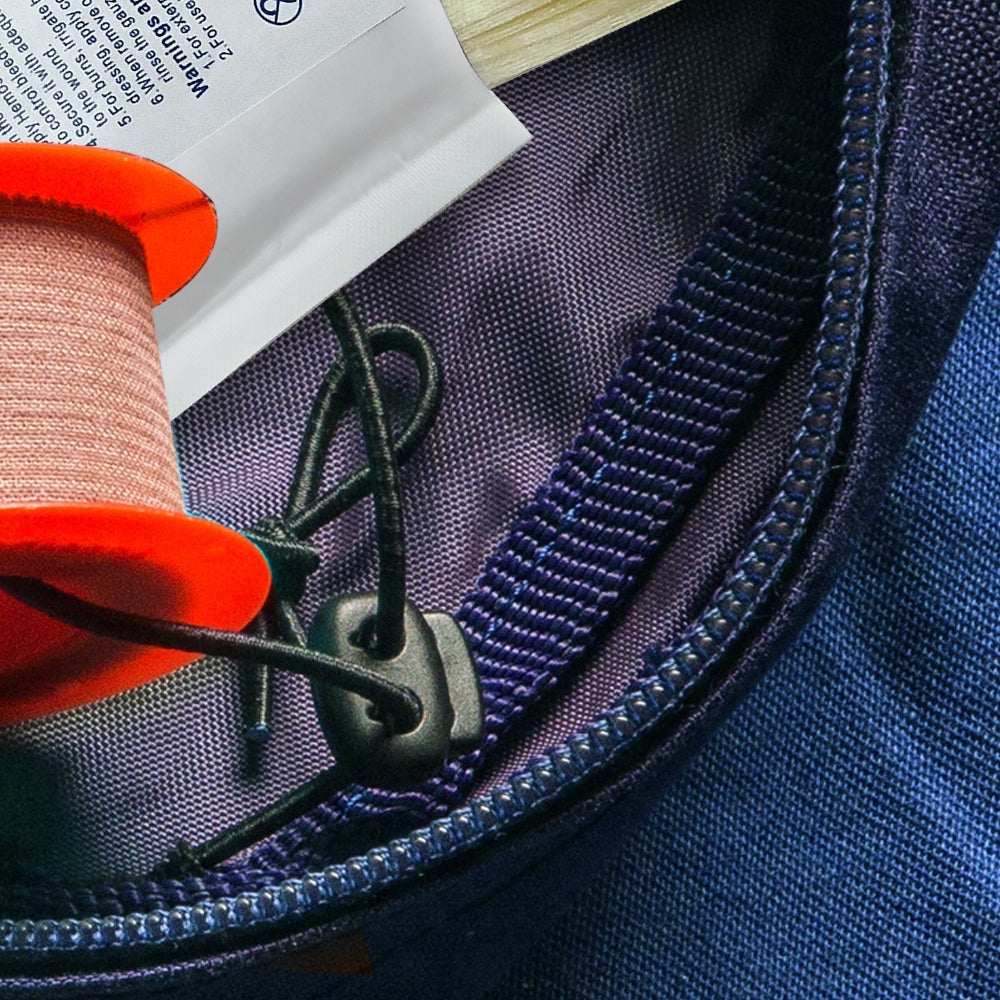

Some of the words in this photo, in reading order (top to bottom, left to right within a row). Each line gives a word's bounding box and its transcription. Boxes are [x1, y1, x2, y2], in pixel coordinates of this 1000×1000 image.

[37, 3, 77, 52] irrigate
[64, 9, 98, 46] apply
[87, 5, 129, 55] remove
[128, 27, 150, 52] the
[201, 23, 234, 61] 2.For
[23, 51, 49, 82] with
[41, 42, 81, 92] wound.
[73, 47, 107, 94] burns,
[144, 48, 174, 84] rinse
[145, 14, 209, 100] Warnings
[184, 34, 216, 70] 1.For
[40, 78, 57, 94] it
[94, 42, 141, 104] dressing,
[123, 52, 165, 106] 6.When
[19, 84, 61, 131] control
[75, 88, 98, 114] the
[92, 110, 109, 128] to
[100, 90, 132, 128] 5.For
